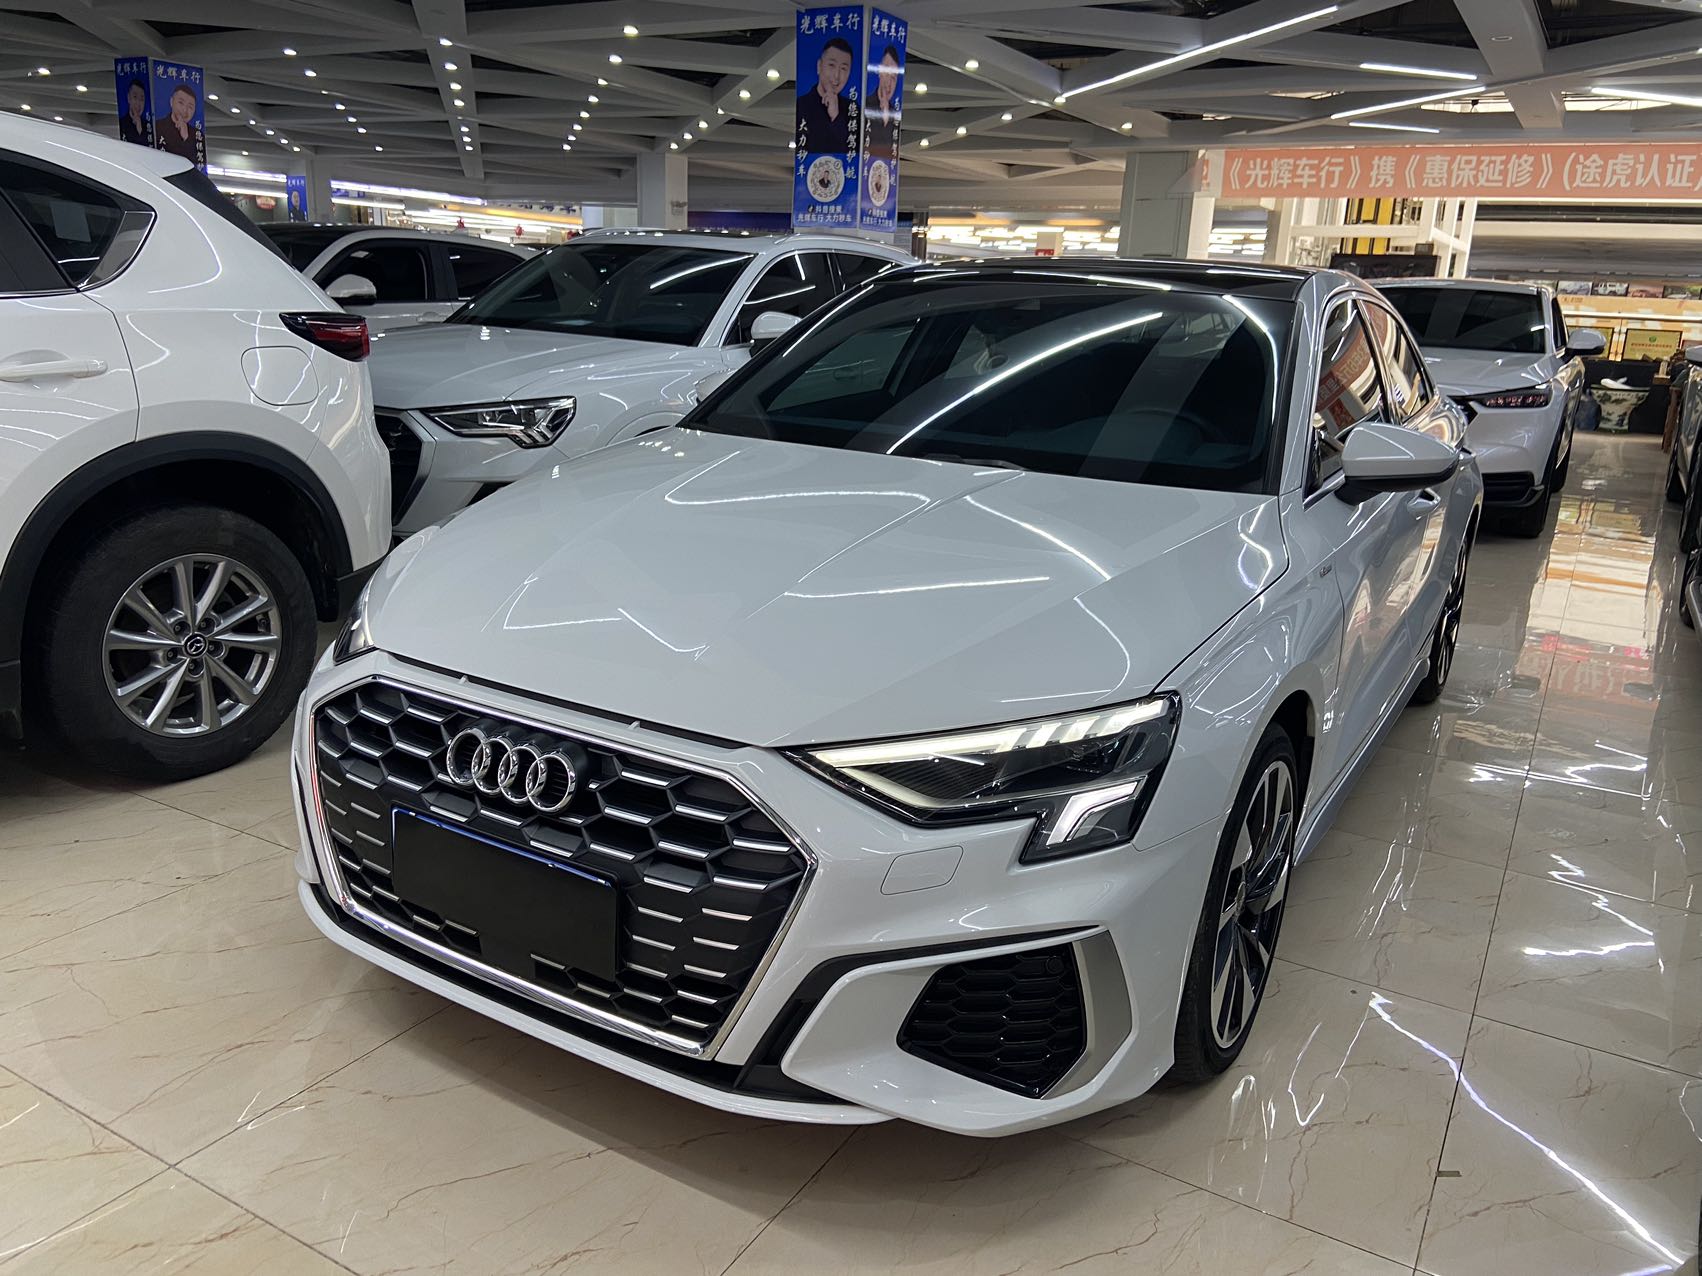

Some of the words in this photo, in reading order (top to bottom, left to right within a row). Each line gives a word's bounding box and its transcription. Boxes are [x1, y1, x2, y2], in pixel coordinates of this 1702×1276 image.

[800, 12, 860, 34] 光辉车行
[157, 65, 200, 84] 光辉车行
